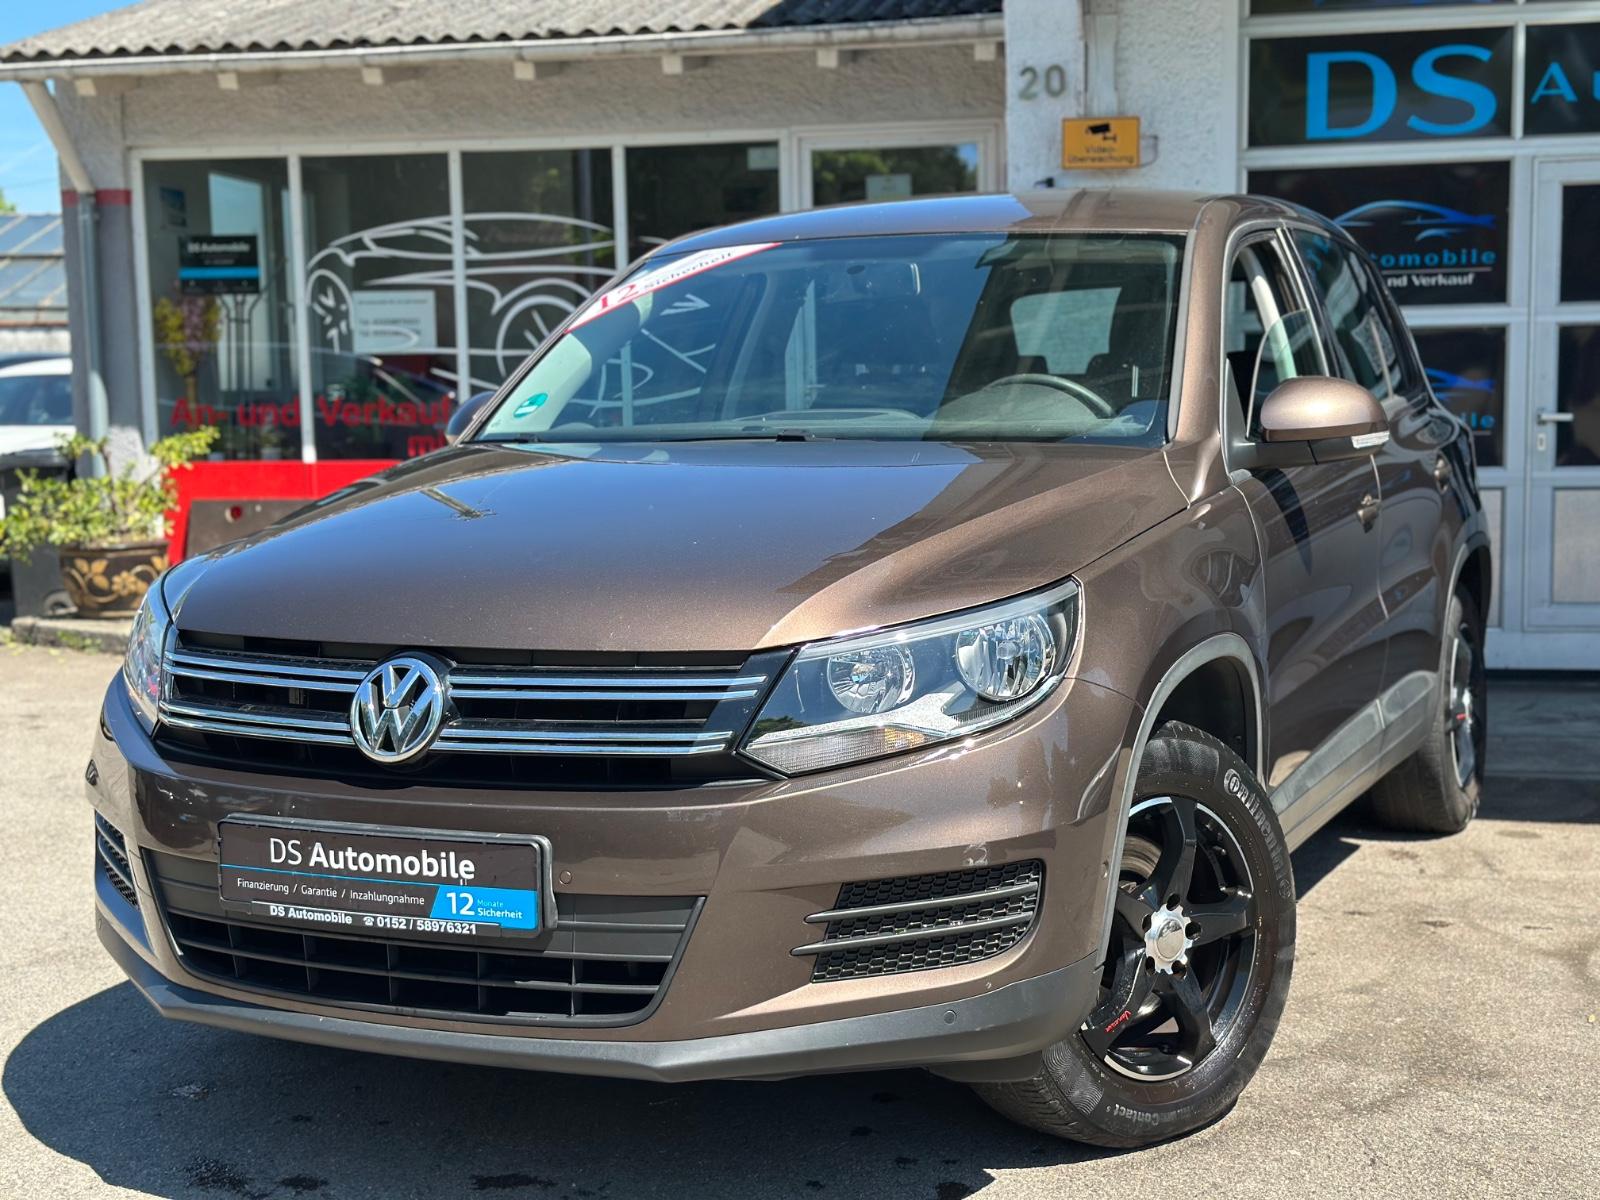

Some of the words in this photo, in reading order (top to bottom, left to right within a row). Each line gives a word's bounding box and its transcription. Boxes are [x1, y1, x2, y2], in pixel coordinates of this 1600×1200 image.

[1018, 64, 1066, 100] 20
[1305, 44, 1497, 140] DS
[1371, 248, 1497, 268] omobile
[1411, 273, 1475, 287] Verkauf
[600, 284, 639, 308] 12
[170, 398, 229, 427] An-
[236, 398, 300, 427] und
[316, 394, 450, 427] Verkauf
[269, 837, 303, 865] DS
[309, 842, 475, 879] Automobile
[237, 877, 290, 895] Finanzierung
[301, 886, 338, 898] Garantie
[350, 889, 425, 905] Inzahlungnahme
[446, 892, 475, 916] 12
[477, 899, 504, 908] Monate
[269, 905, 286, 917] DS
[288, 907, 353, 925] Automobile
[376, 916, 407, 930] 0152
[416, 919, 477, 935] 58976321
[477, 907, 523, 919] Sicherheit
